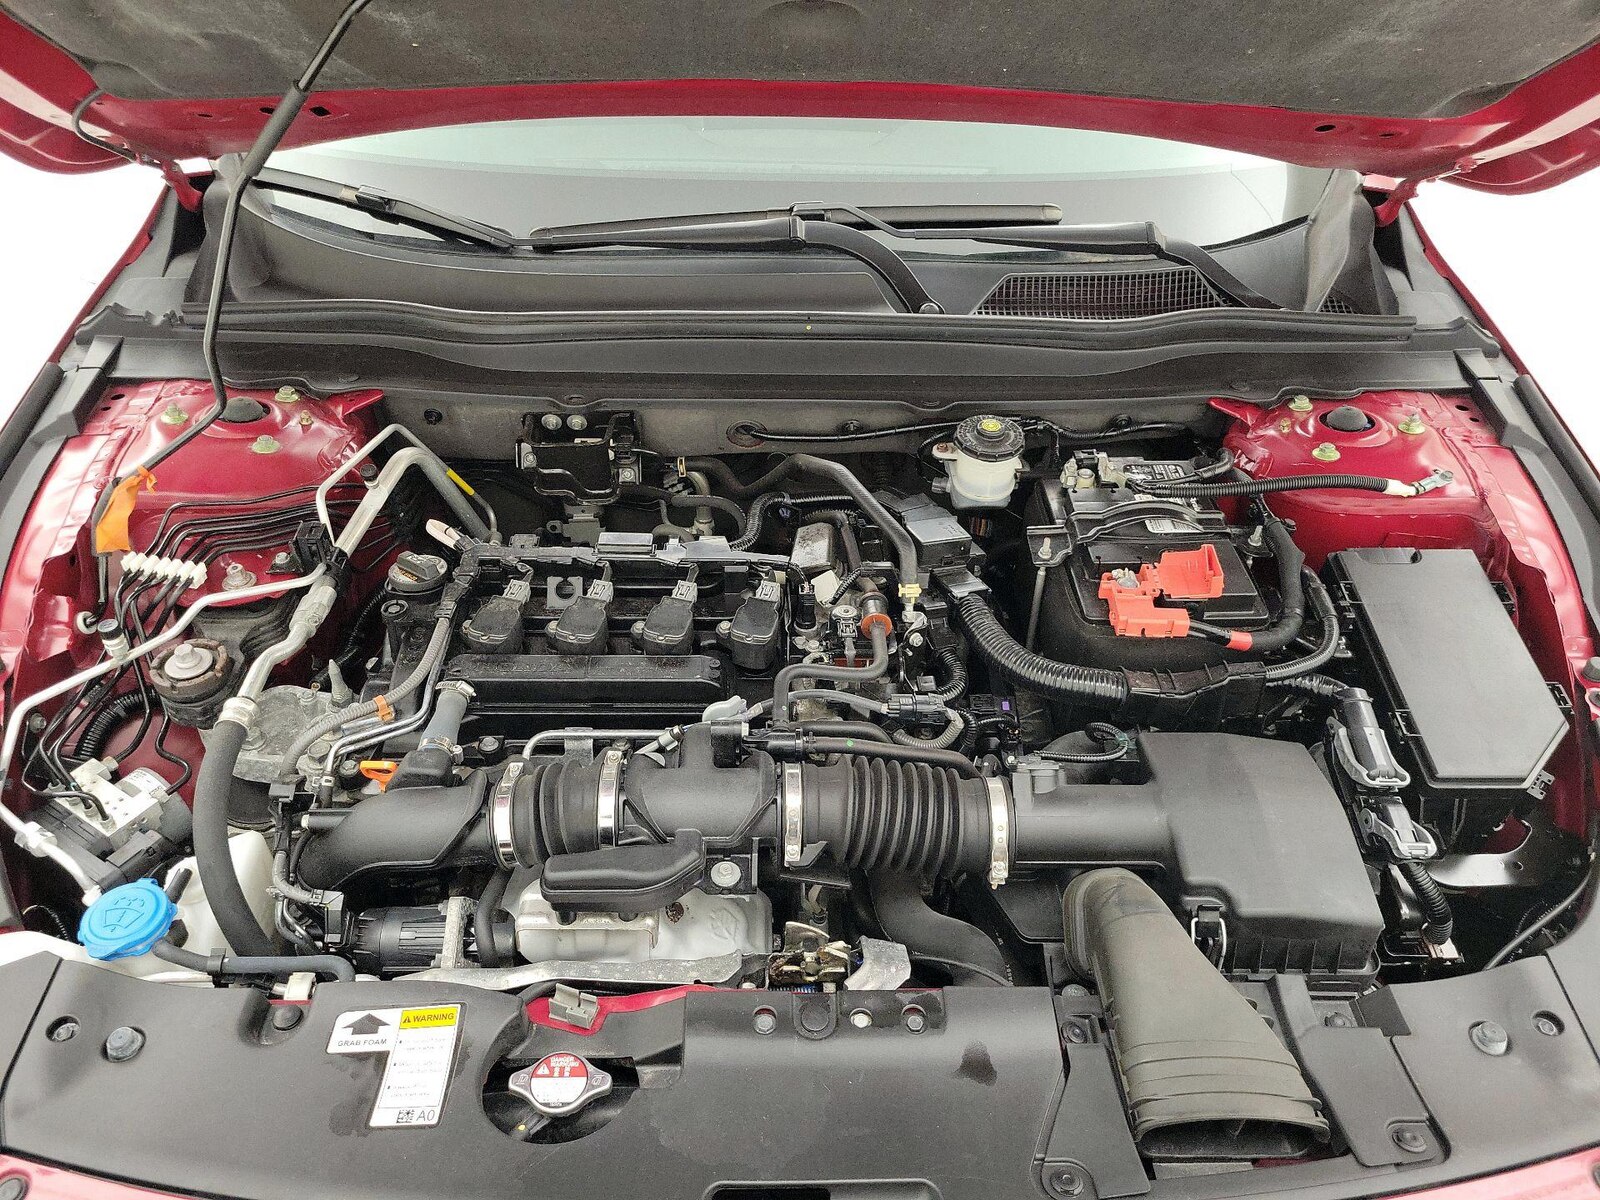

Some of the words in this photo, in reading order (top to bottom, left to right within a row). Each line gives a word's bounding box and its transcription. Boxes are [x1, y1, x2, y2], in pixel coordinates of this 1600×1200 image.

[413, 1013, 455, 1023] WARNING
[337, 1039, 361, 1047] GRAB
[363, 1038, 387, 1046] FOAM
